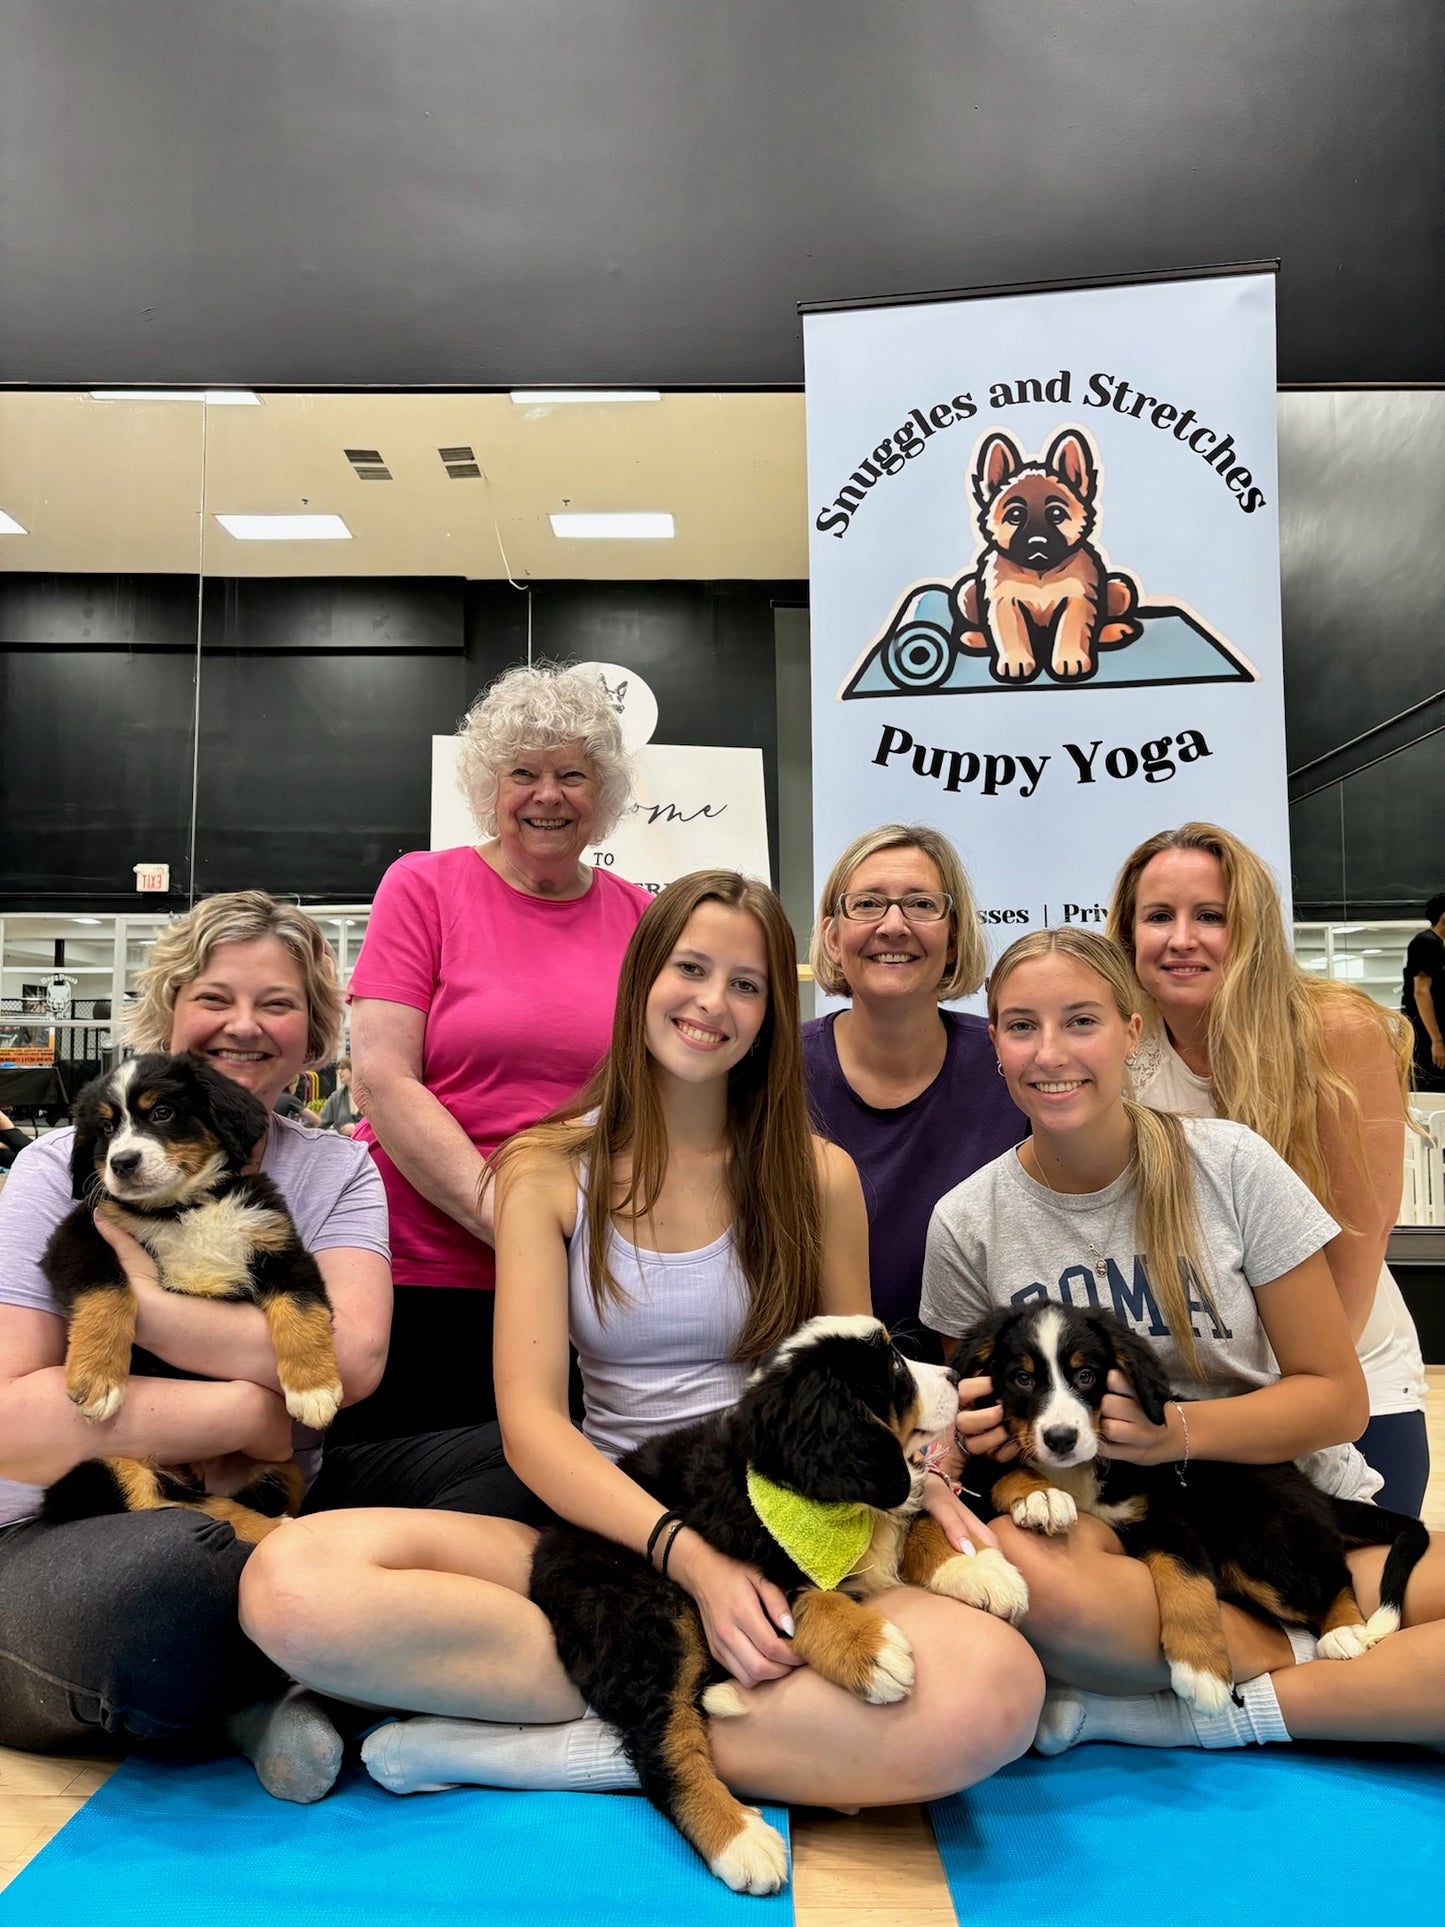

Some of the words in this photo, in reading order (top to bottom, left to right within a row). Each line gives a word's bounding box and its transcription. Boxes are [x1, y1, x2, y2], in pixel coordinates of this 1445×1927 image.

[816, 391, 978, 539] Snuggles
[989, 370, 1072, 409] and
[1082, 373, 1267, 514] Stretches
[871, 724, 1052, 797] Puppy
[1062, 729, 1213, 784] Yoga
[631, 802, 728, 825] ome
[593, 852, 615, 867] TO
[976, 908, 1030, 924] sses
[1063, 903, 1108, 923] Priv
